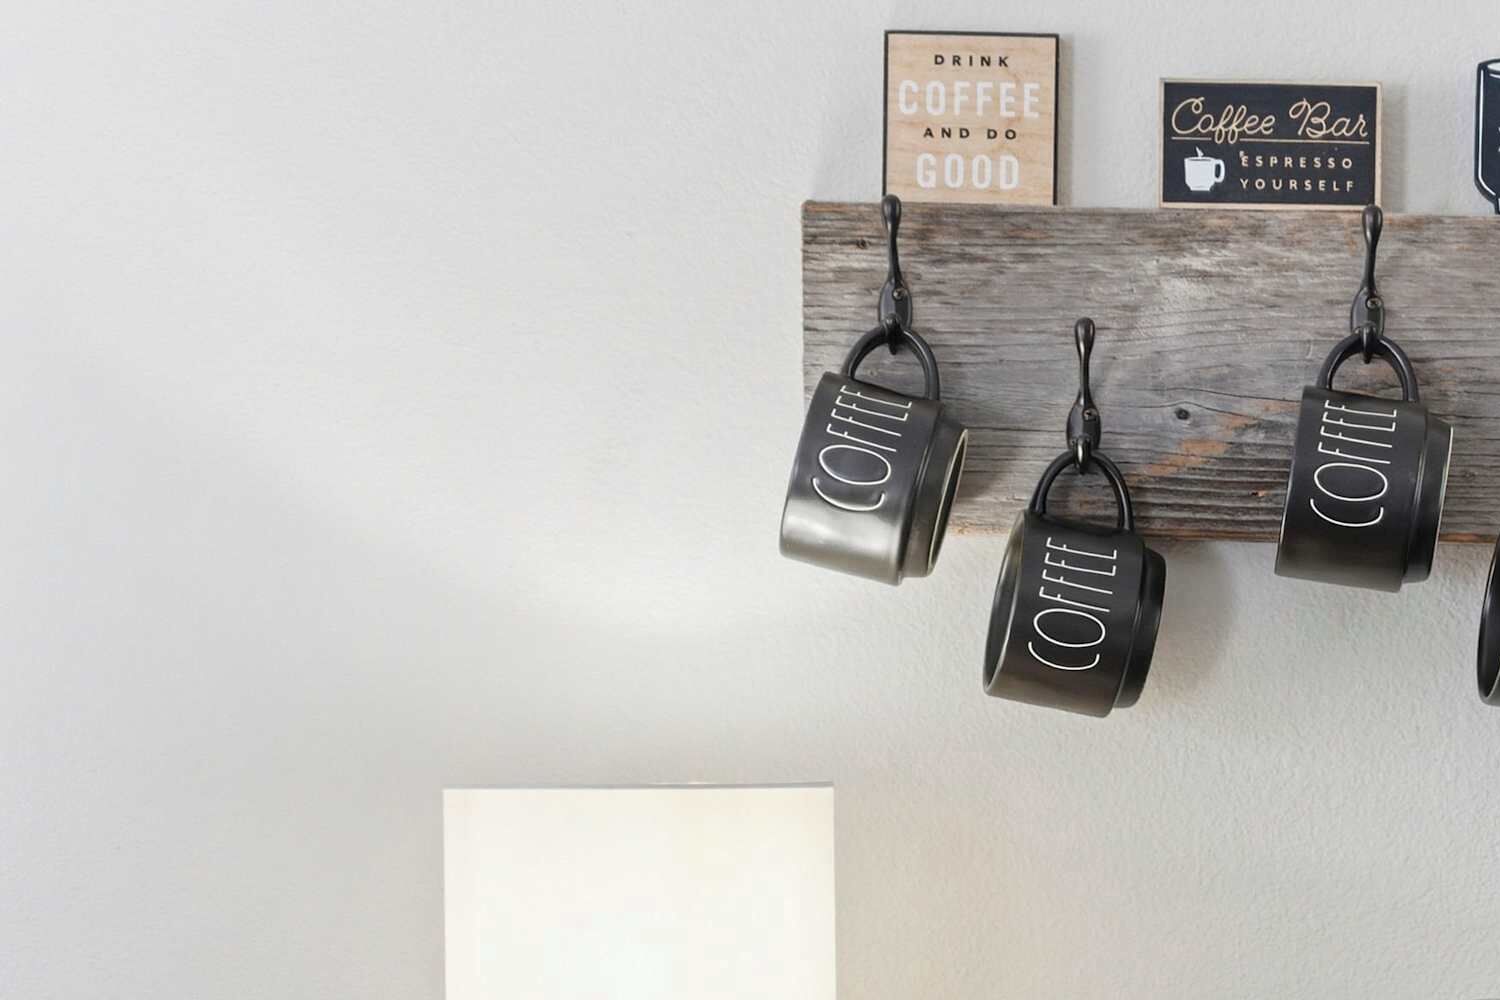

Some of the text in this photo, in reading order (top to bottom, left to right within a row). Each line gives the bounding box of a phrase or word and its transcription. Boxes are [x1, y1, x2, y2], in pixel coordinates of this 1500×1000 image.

[933, 54, 1010, 68] DRINK
[898, 79, 1041, 118] COFFEE
[923, 126, 1018, 141] AND DO
[1171, 97, 1369, 144] Coffee Bar
[915, 152, 1021, 191] GOOD
[1240, 155, 1353, 169] ESPRESSO
[1239, 178, 1355, 192] YOURSELF
[812, 384, 912, 512] COFFEE
[1310, 399, 1398, 527] COFFEE
[1027, 536, 1117, 671] COFFEE
